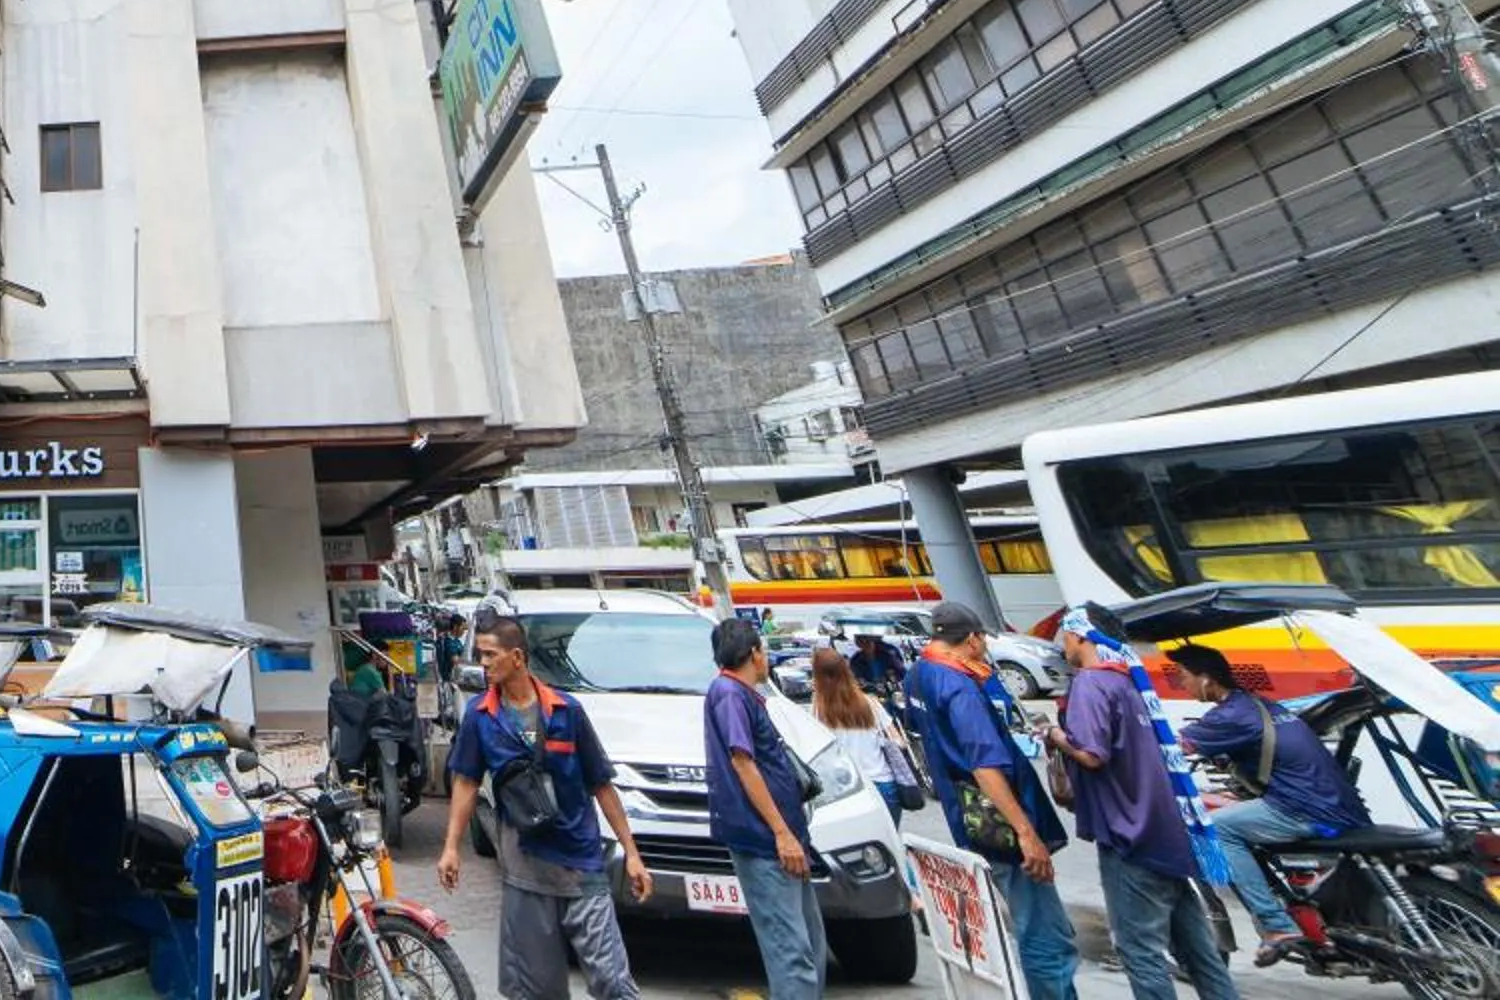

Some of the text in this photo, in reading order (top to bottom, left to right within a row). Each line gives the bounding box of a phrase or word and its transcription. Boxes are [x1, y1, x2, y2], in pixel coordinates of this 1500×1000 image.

[668, 766, 707, 780] ISU
[691, 881, 725, 902] SAA
[214, 876, 262, 1000] 3102
